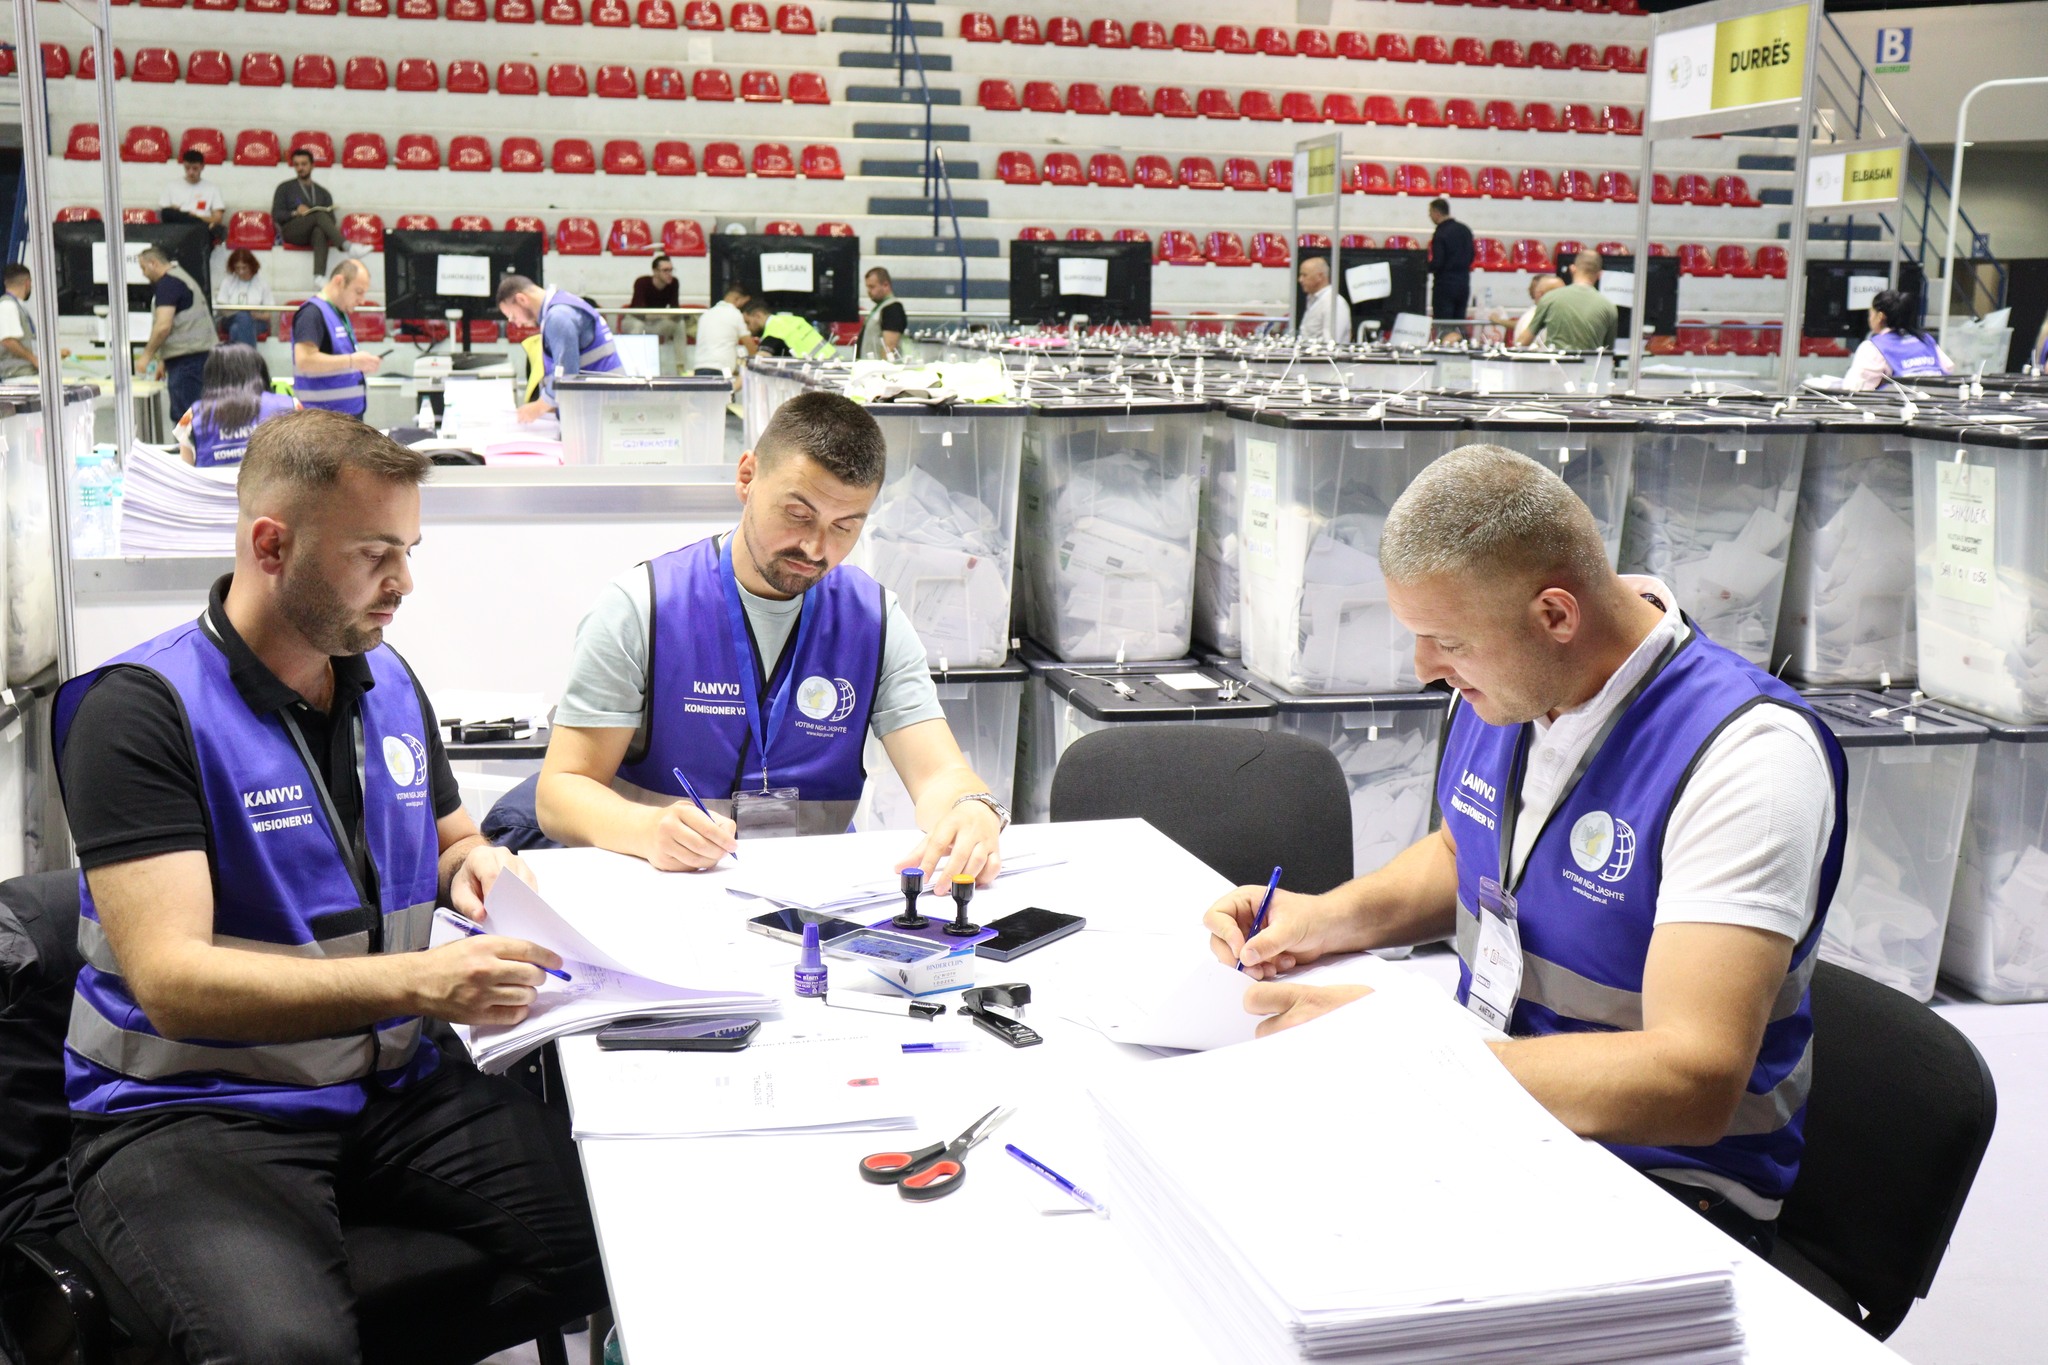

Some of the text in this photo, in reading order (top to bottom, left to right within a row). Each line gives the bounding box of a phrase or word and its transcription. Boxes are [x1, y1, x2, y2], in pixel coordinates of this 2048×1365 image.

[1882, 28, 1906, 62] B
[1730, 38, 1790, 73] DURRËS
[1852, 167, 1893, 183] ELBASAN
[767, 264, 807, 273] ELBASAN
[1853, 285, 1884, 294] ELBASA
[693, 680, 740, 696] KANVVJ
[684, 703, 746, 715] KOMISIONER VJ
[794, 720, 814, 730] VOTIMI
[243, 784, 303, 808] KANVVJ
[251, 813, 313, 833] MISIONER VJ
[1487, 816, 1495, 831] VJ
[1562, 868, 1625, 902] VOTIMI NGA JASHTË
[926, 959, 964, 971] BINDER CLIPS
